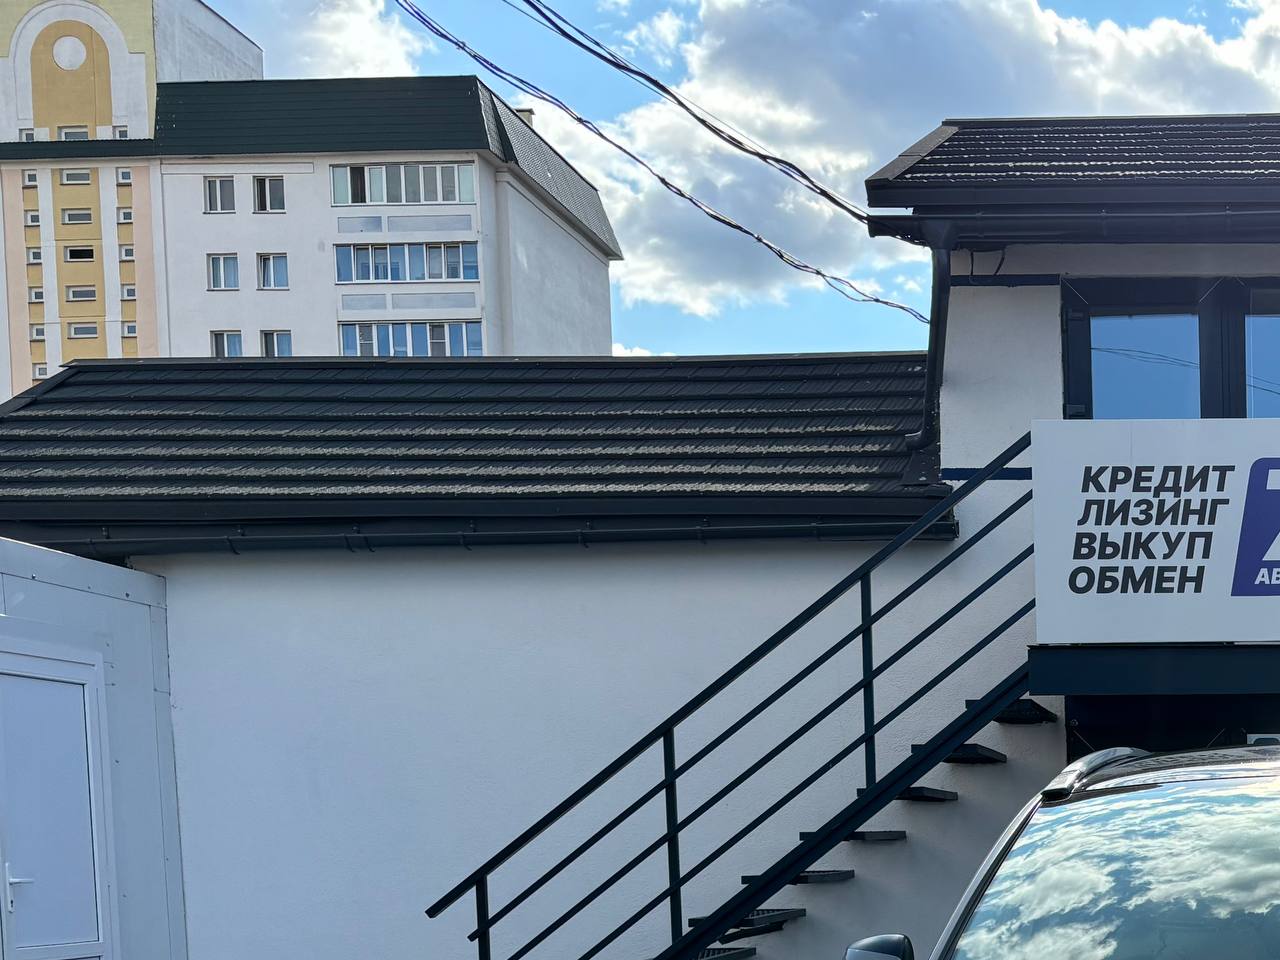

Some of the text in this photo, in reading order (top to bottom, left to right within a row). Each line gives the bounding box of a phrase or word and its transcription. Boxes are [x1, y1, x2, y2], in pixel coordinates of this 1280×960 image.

[1081, 465, 1236, 499] КРЕДИТ
[1077, 498, 1230, 526] ЛИЗИНГ
[1072, 531, 1213, 560] ВЫКУП
[1068, 565, 1206, 594] ОБМЕН
